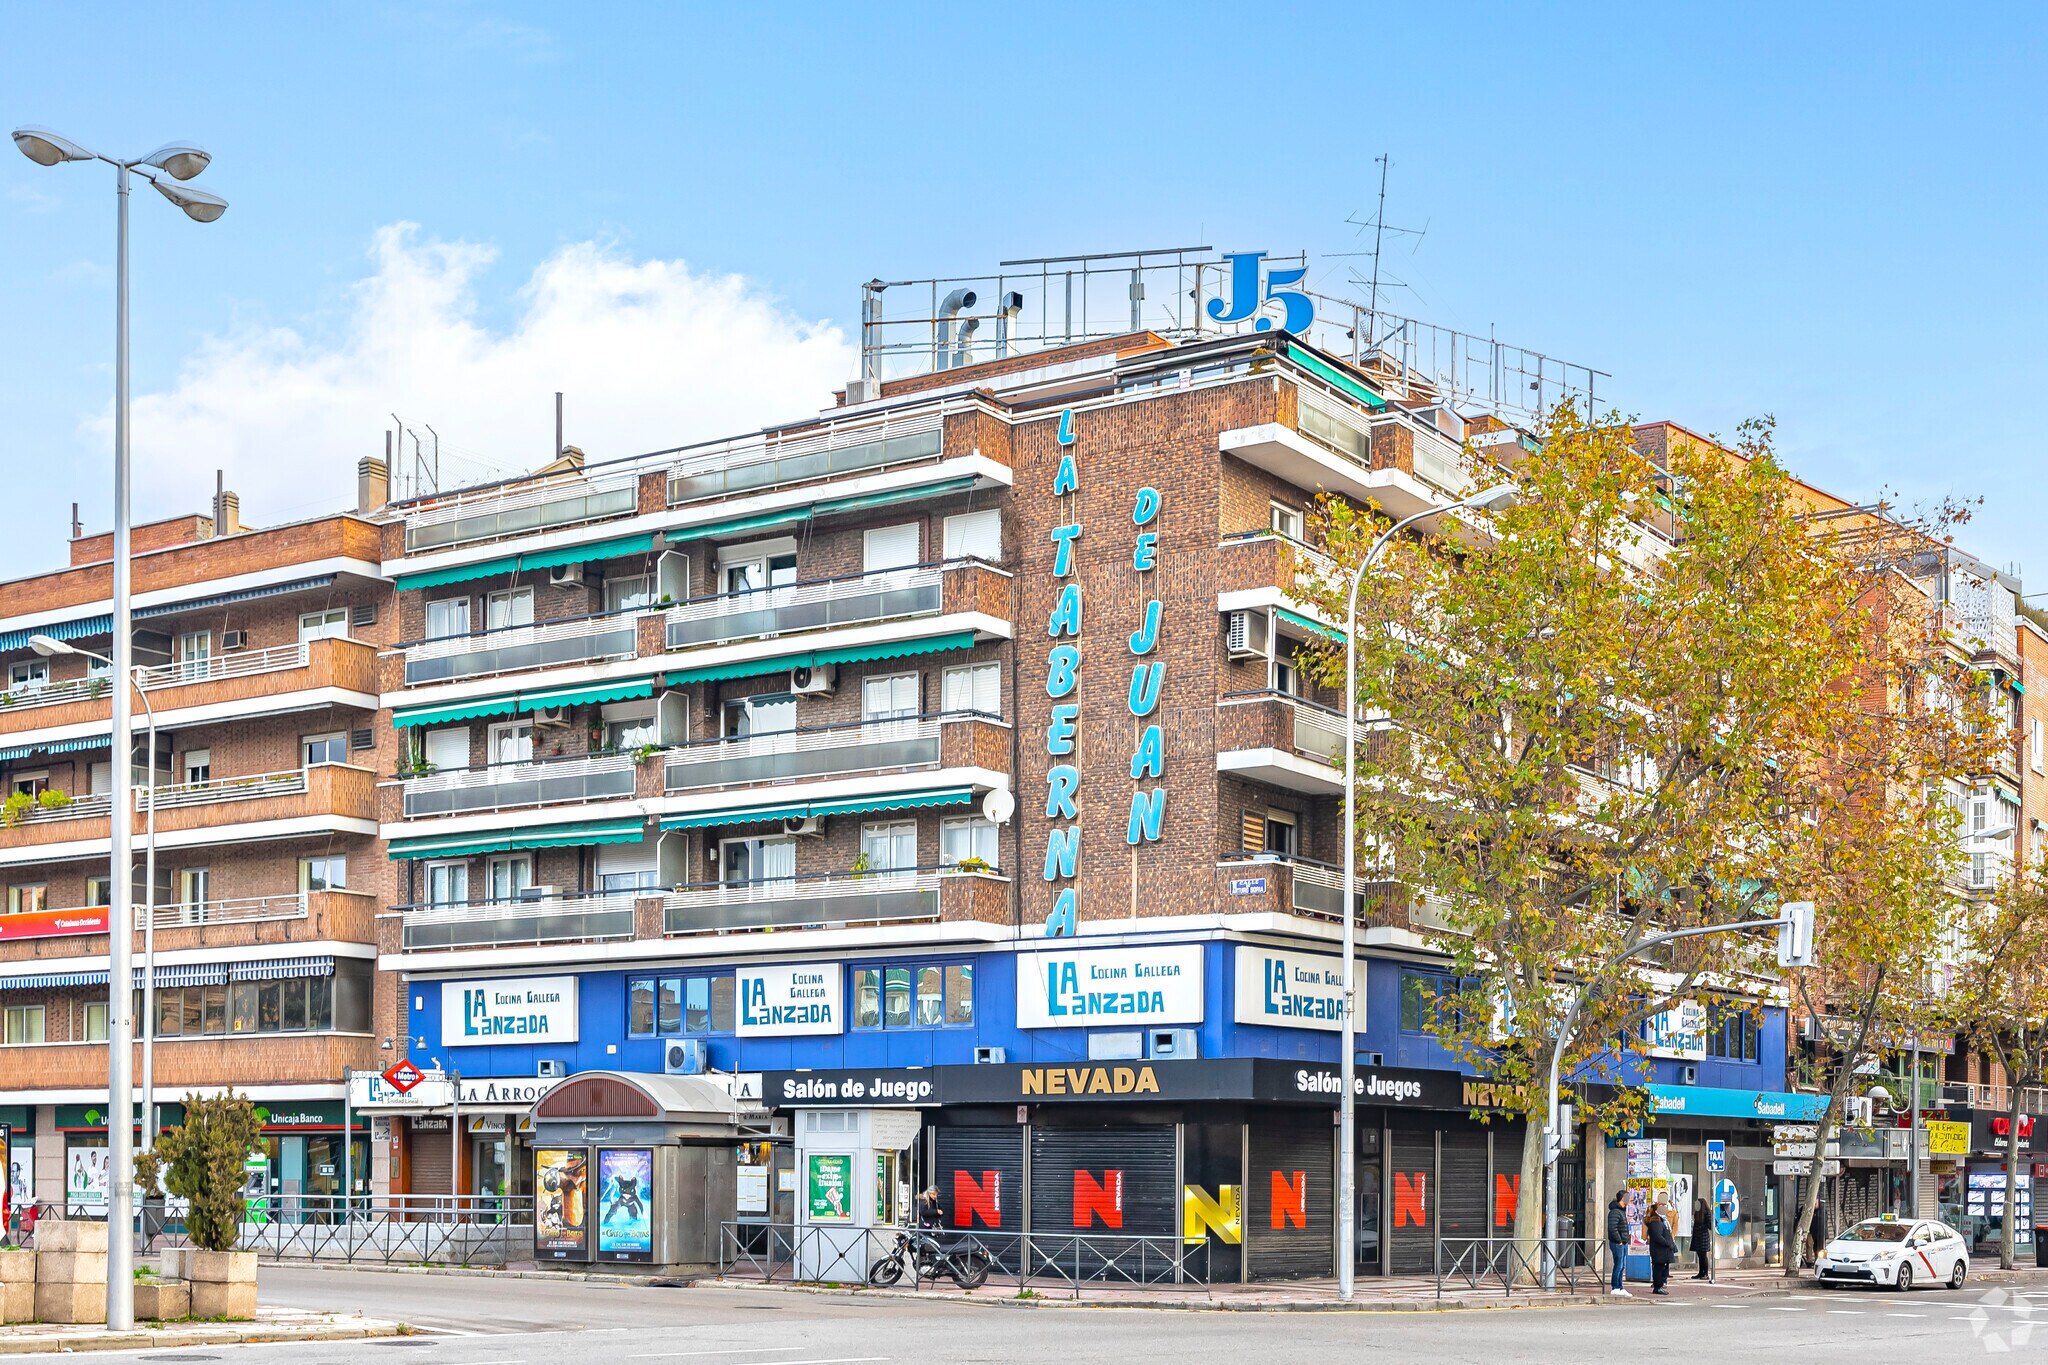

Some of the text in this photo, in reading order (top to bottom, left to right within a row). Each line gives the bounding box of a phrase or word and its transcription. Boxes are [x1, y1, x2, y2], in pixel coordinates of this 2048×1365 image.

[1127, 600, 1167, 846] JUAN
[397, 1073, 417, 1081] Metro
[1021, 1066, 1160, 1095] NEVADA
[783, 1078, 934, 1102] Salón de Juego
[1366, 1075, 1421, 1102] Juegos
[271, 1112, 323, 1125] Unicaja Banco
[1757, 1102, 1785, 1116] Sabadell
[1708, 1151, 1724, 1161] TAXI
